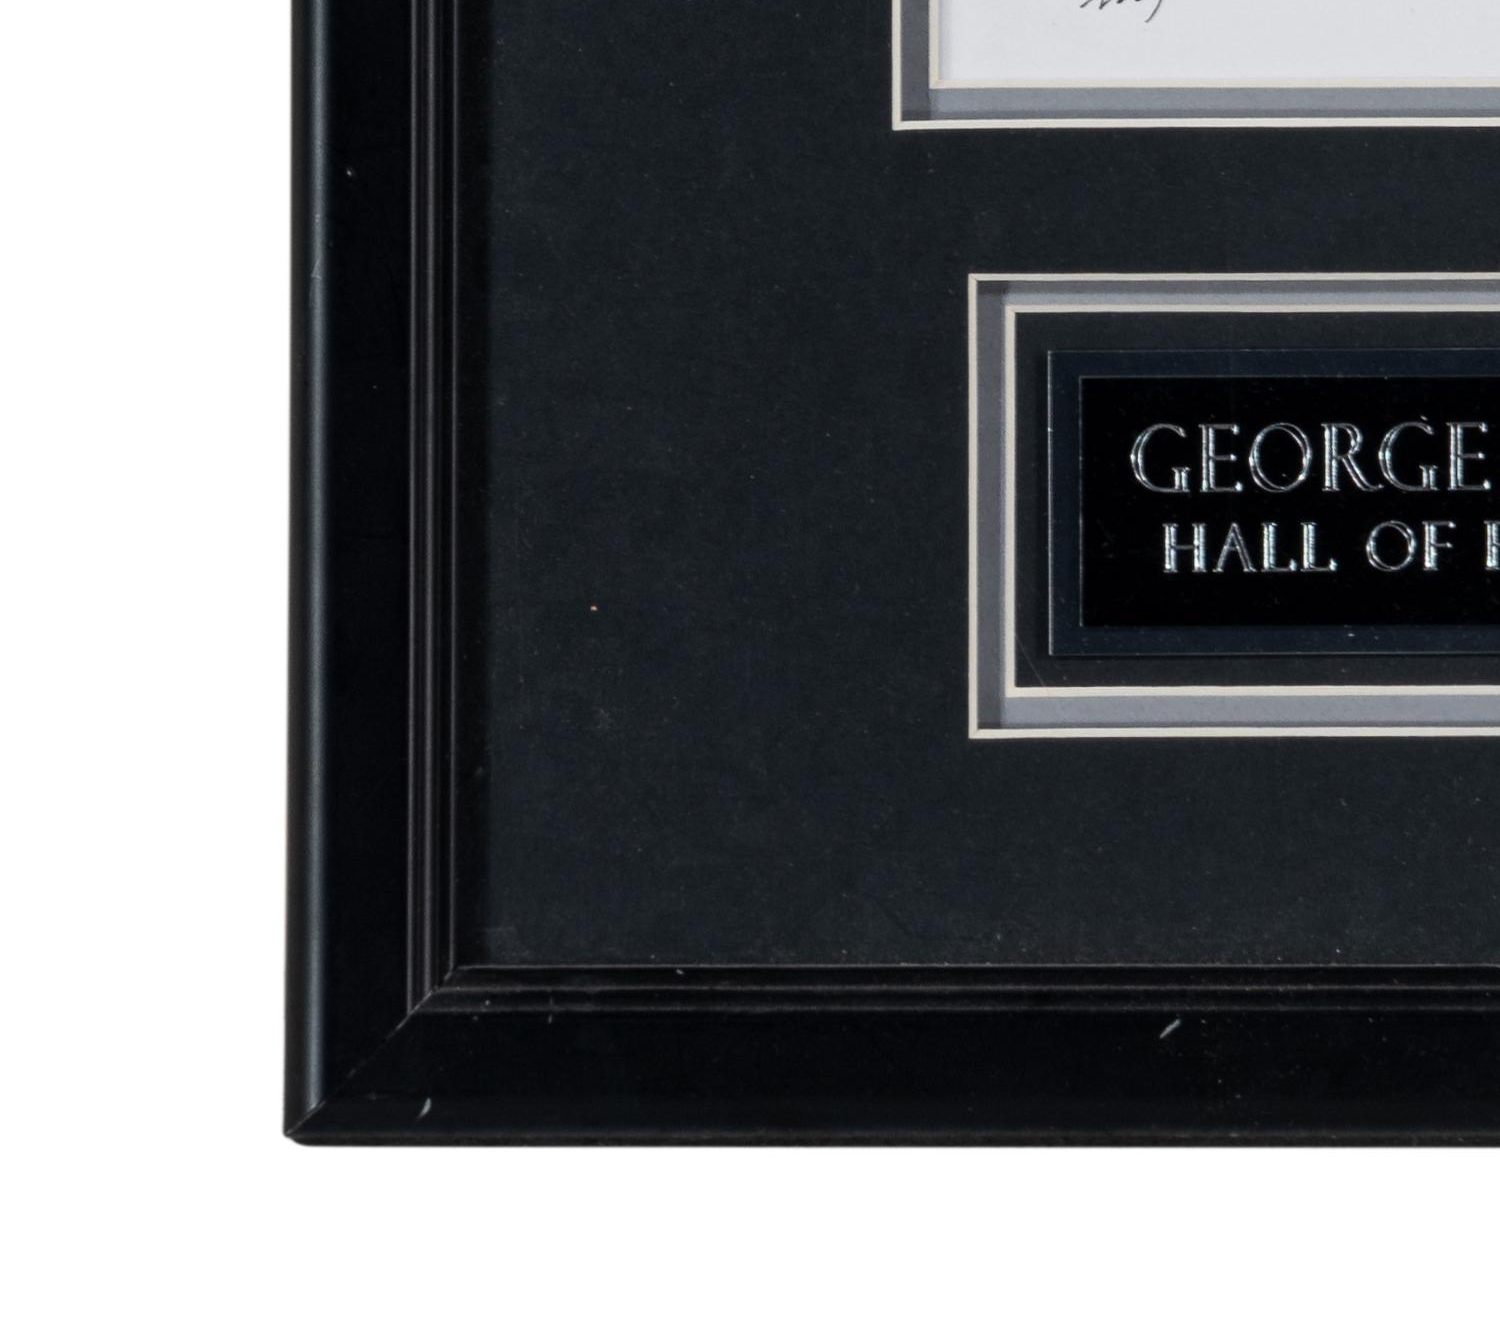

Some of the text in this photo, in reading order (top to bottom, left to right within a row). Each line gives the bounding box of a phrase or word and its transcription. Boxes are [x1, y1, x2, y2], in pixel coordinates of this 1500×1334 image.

[1129, 422, 1492, 493] GEORGE
[1162, 521, 1338, 573] HALL
[1365, 520, 1456, 571] OF
